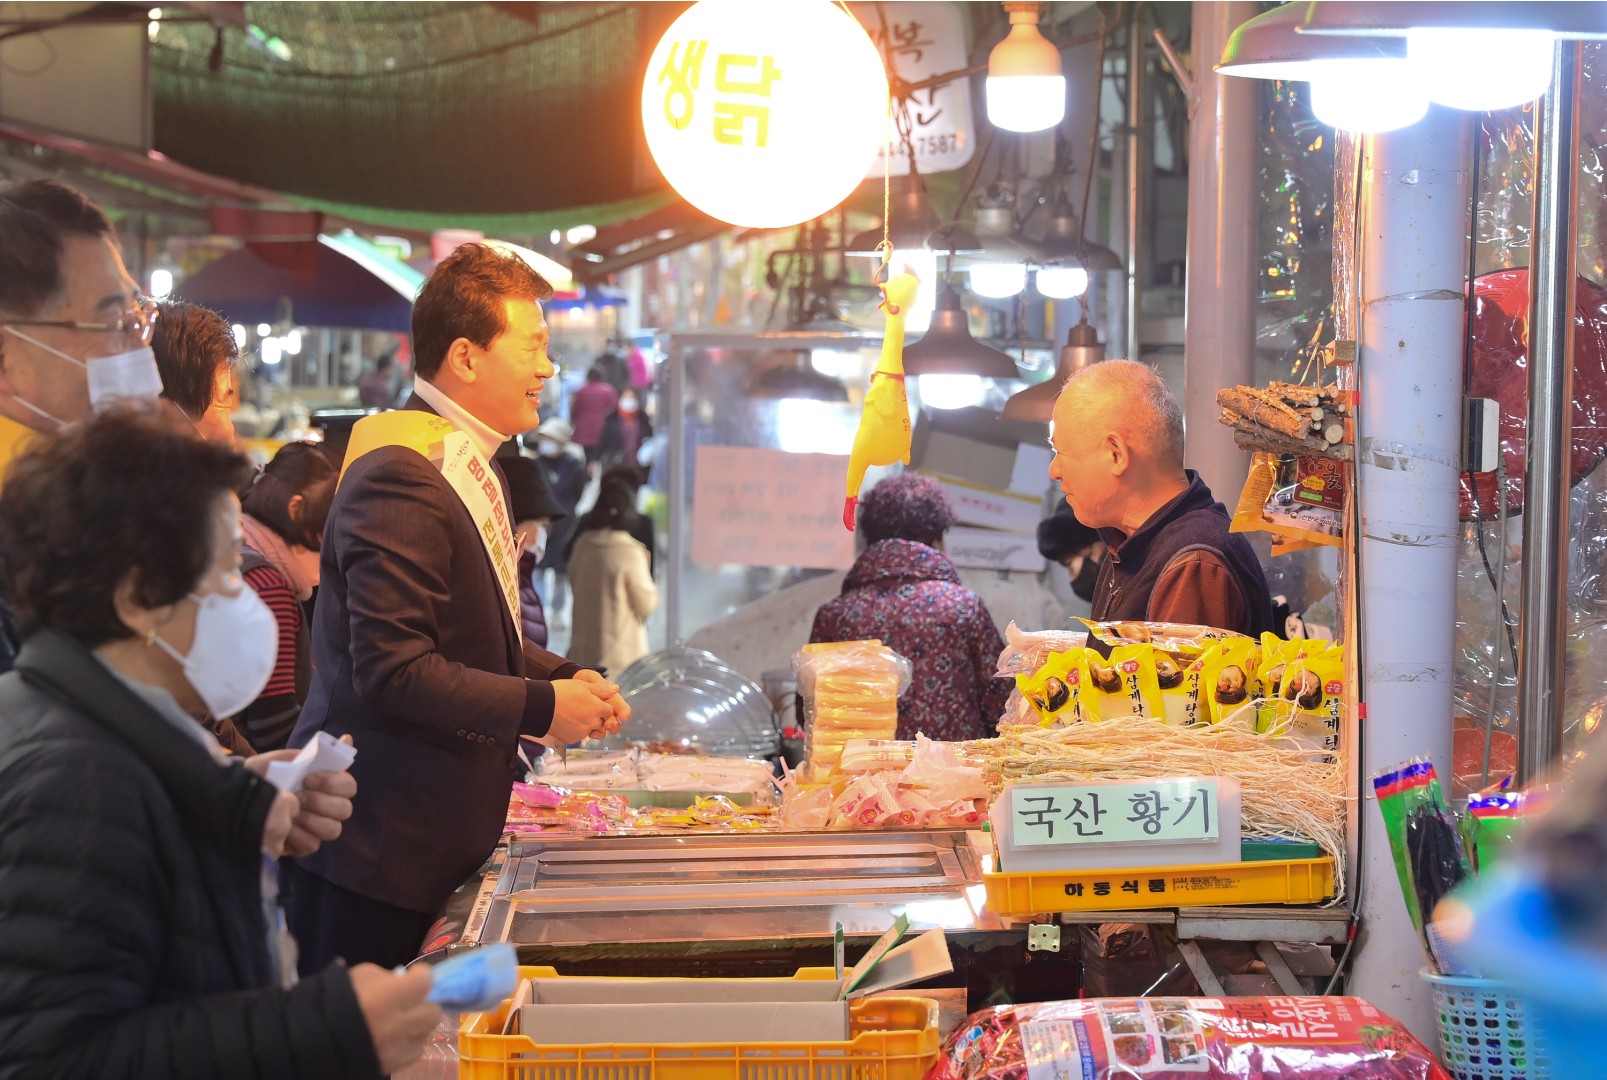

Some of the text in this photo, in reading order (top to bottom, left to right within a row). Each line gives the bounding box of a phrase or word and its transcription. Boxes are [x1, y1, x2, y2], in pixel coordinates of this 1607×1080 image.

[657, 39, 782, 148] 생닭
[1018, 788, 1210, 839] 국산 황기
[1265, 996, 1338, 1038] 실홍실
